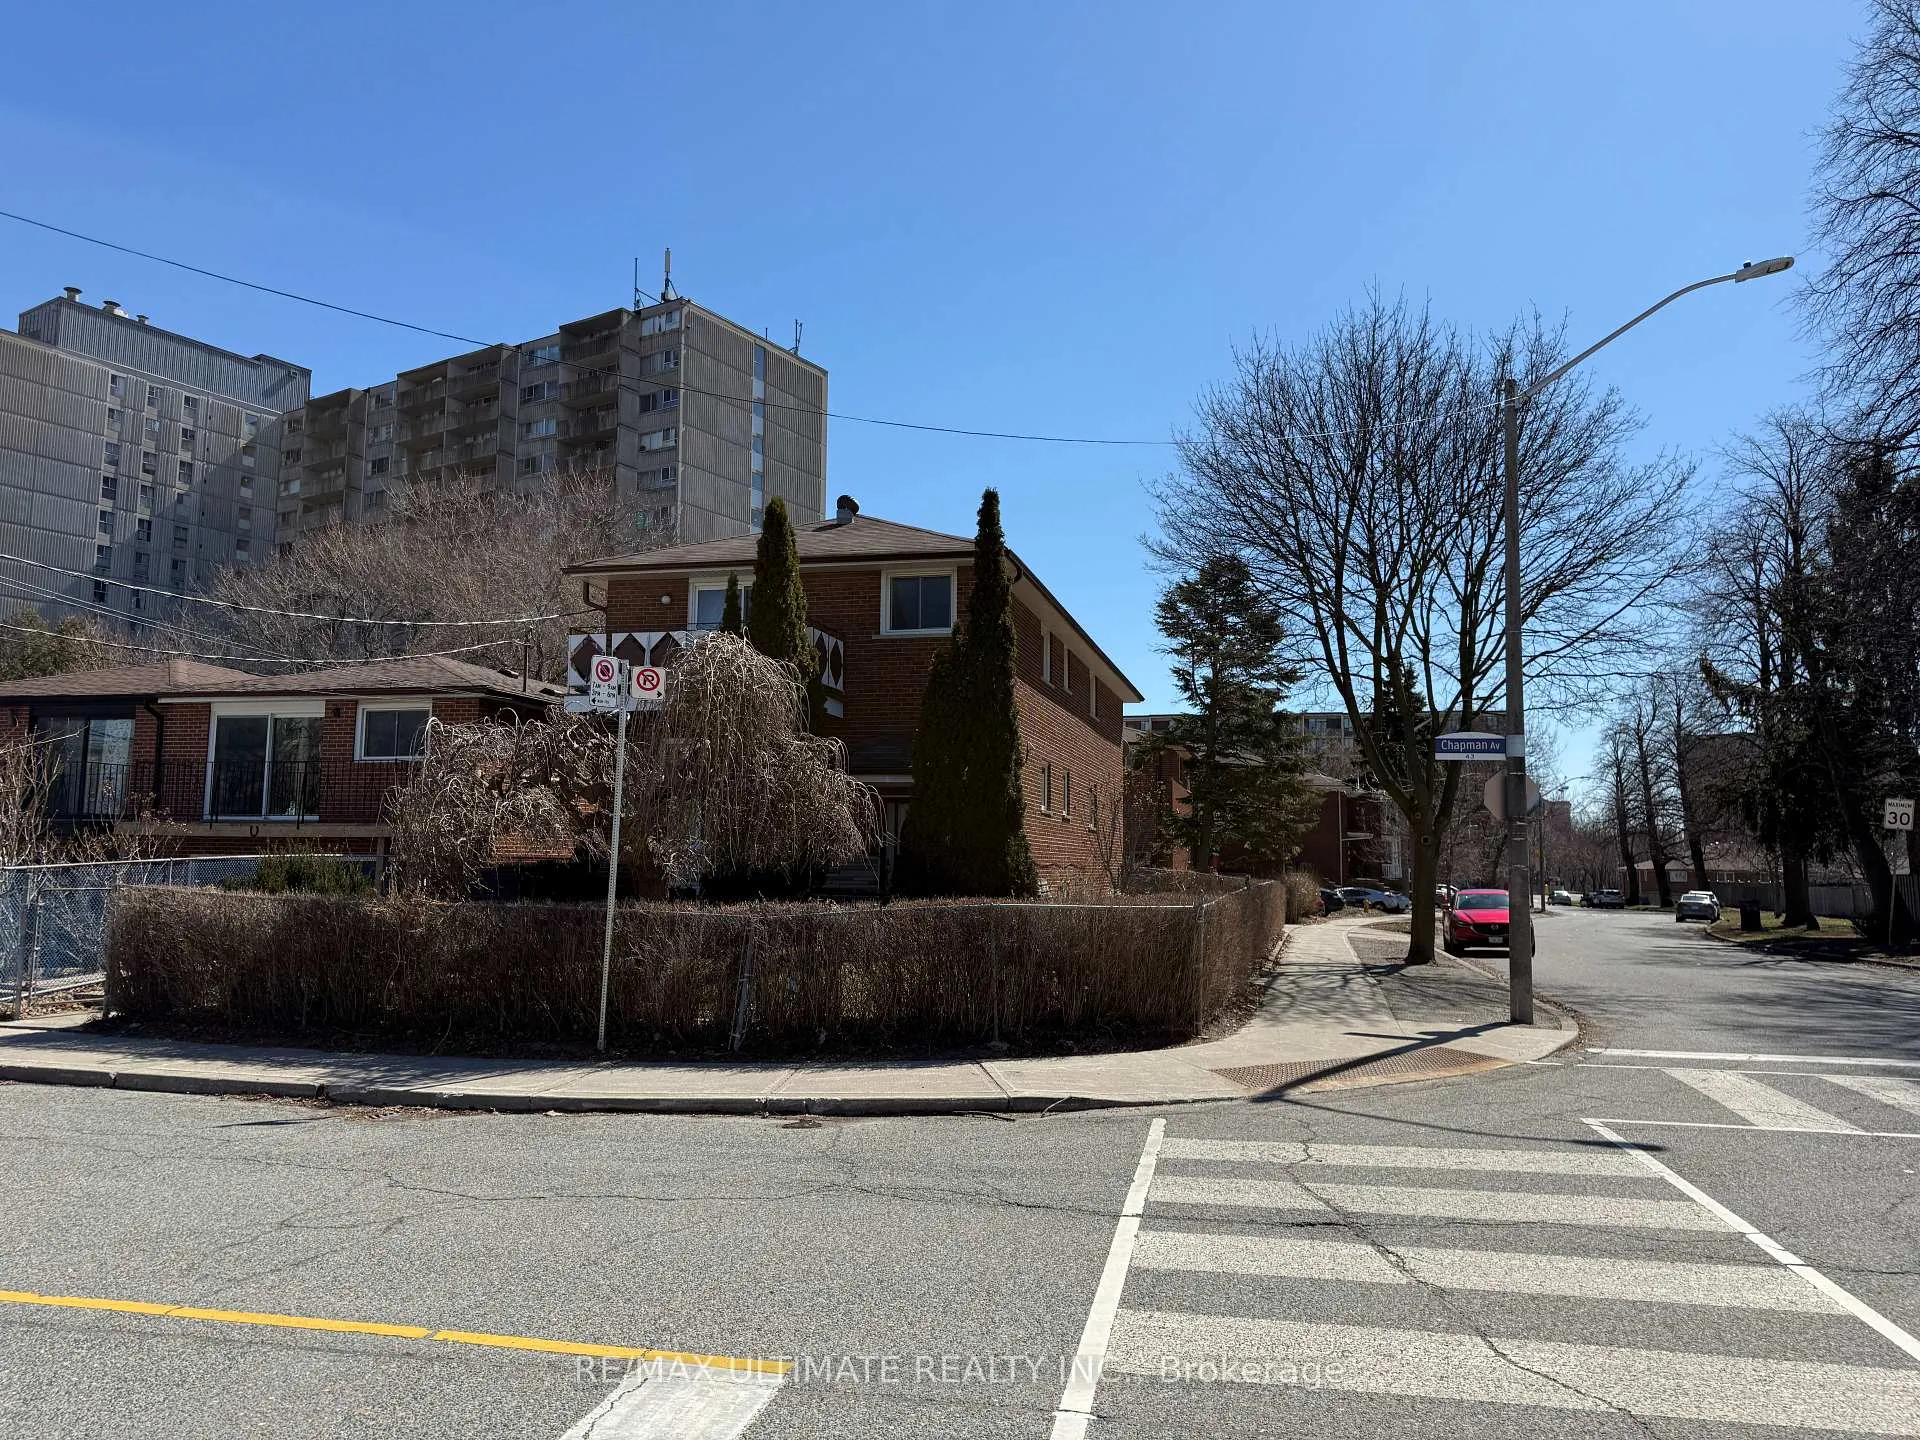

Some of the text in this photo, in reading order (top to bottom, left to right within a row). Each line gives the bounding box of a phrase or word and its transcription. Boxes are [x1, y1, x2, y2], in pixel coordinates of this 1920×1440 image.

[1441, 740, 1500, 752] Chapman Av
[1888, 811, 1910, 825] 30
